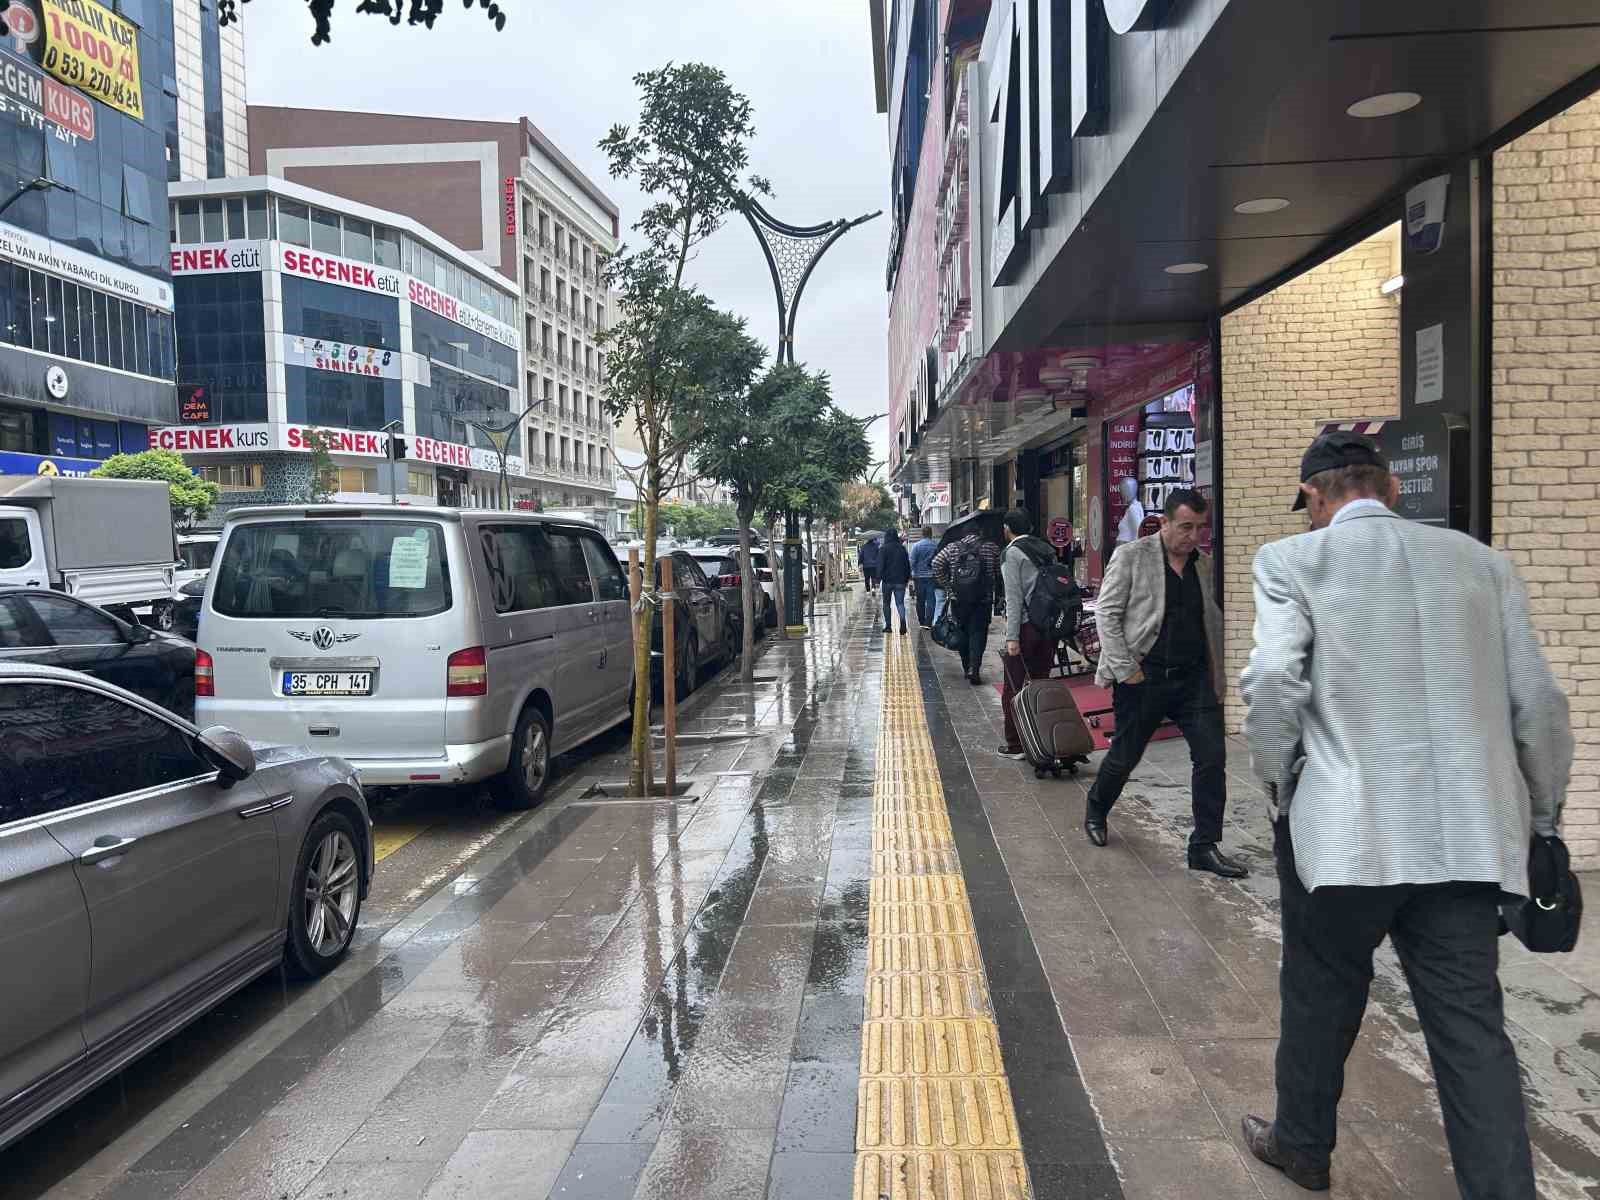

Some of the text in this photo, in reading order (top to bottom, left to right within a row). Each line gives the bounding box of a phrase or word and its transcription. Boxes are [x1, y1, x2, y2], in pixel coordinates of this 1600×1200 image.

[48, 11, 113, 69] 1000
[46, 46, 58, 69] 0
[61, 53, 85, 82] 531
[88, 66, 111, 96] 270
[127, 88, 139, 112] 24
[47, 86, 91, 132] KURS
[231, 248, 260, 268] etüt
[16, 244, 36, 260] VAN
[39, 252, 60, 269] AKIN
[60, 260, 98, 281] YABANCI
[113, 279, 139, 296] KURSU
[284, 250, 400, 294] SEÇENEK etüt
[316, 357, 380, 376] SINIFLAR
[182, 412, 209, 420] CAFE
[183, 402, 207, 410] DEM
[237, 427, 268, 447] kurs
[1114, 424, 1135, 433] SALE
[1402, 433, 1424, 453] GİRİŞ
[1113, 469, 1135, 477] SALE
[1415, 455, 1439, 472] SPOR
[1398, 474, 1433, 494] ESETTÜR
[292, 674, 367, 689] 35 CPH 141
